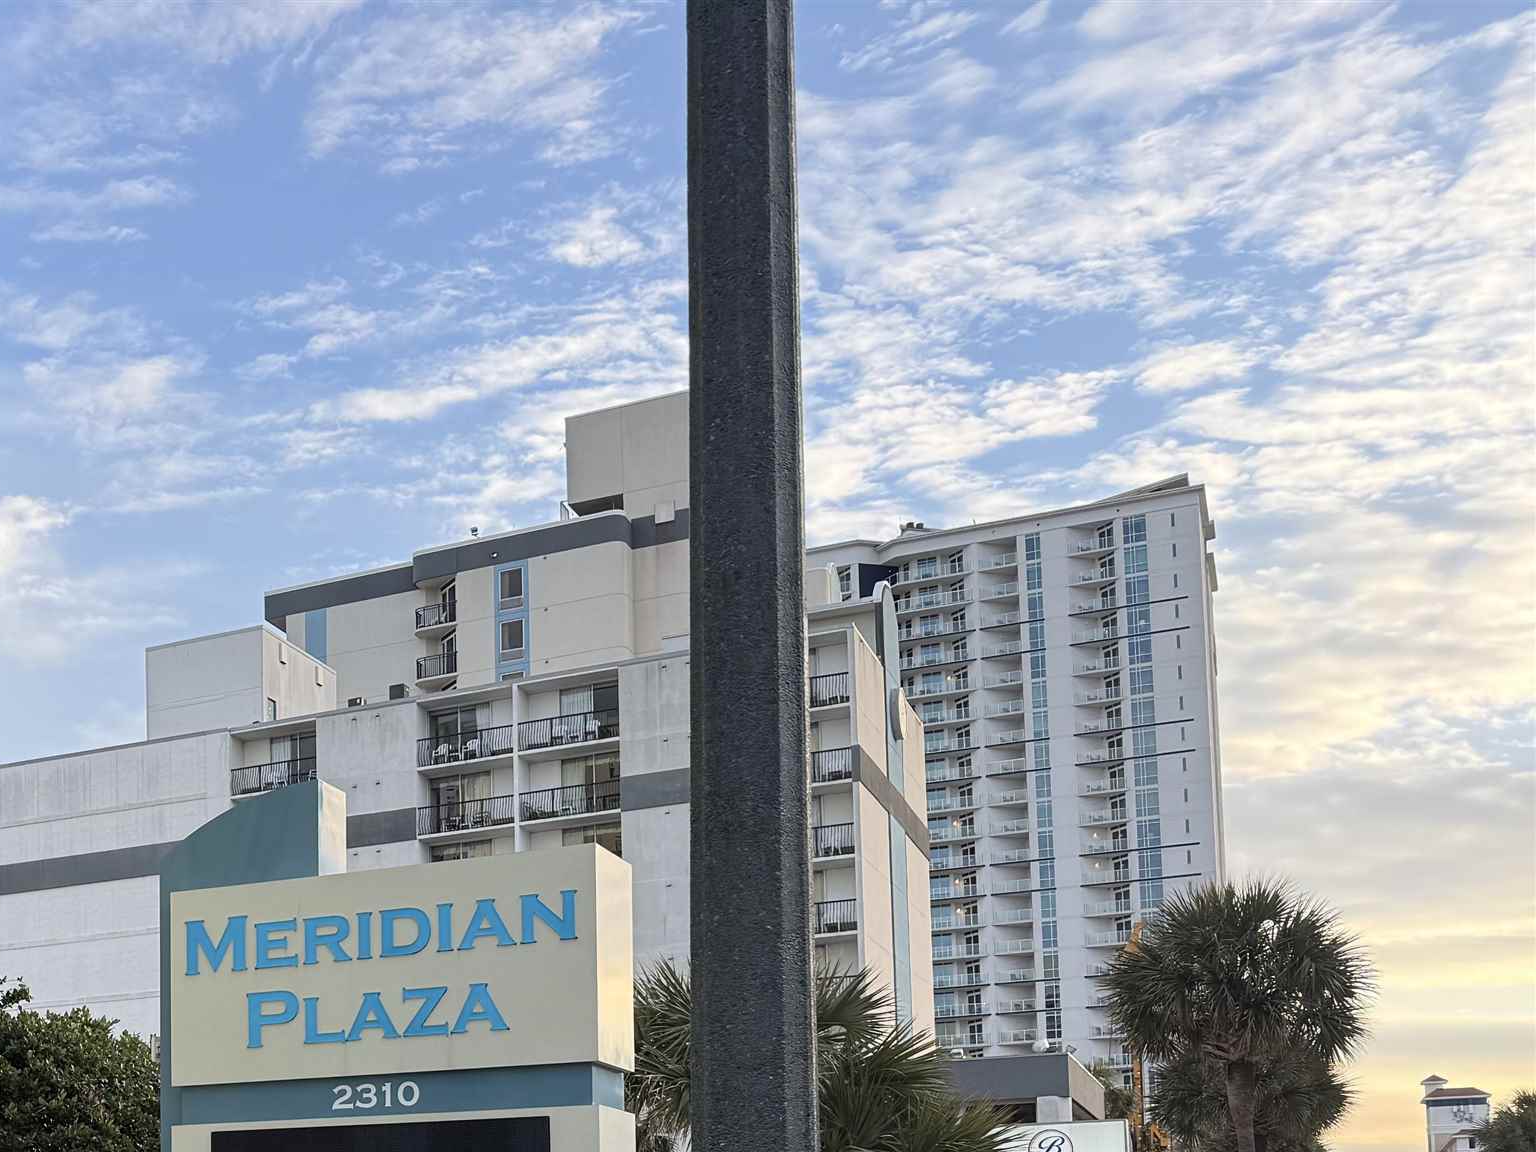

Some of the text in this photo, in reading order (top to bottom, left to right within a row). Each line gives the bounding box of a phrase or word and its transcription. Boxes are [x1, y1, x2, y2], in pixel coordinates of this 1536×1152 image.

[184, 890, 579, 976] MERIDIAN
[246, 982, 510, 1049] PLAZA
[331, 1080, 420, 1110] 2310
